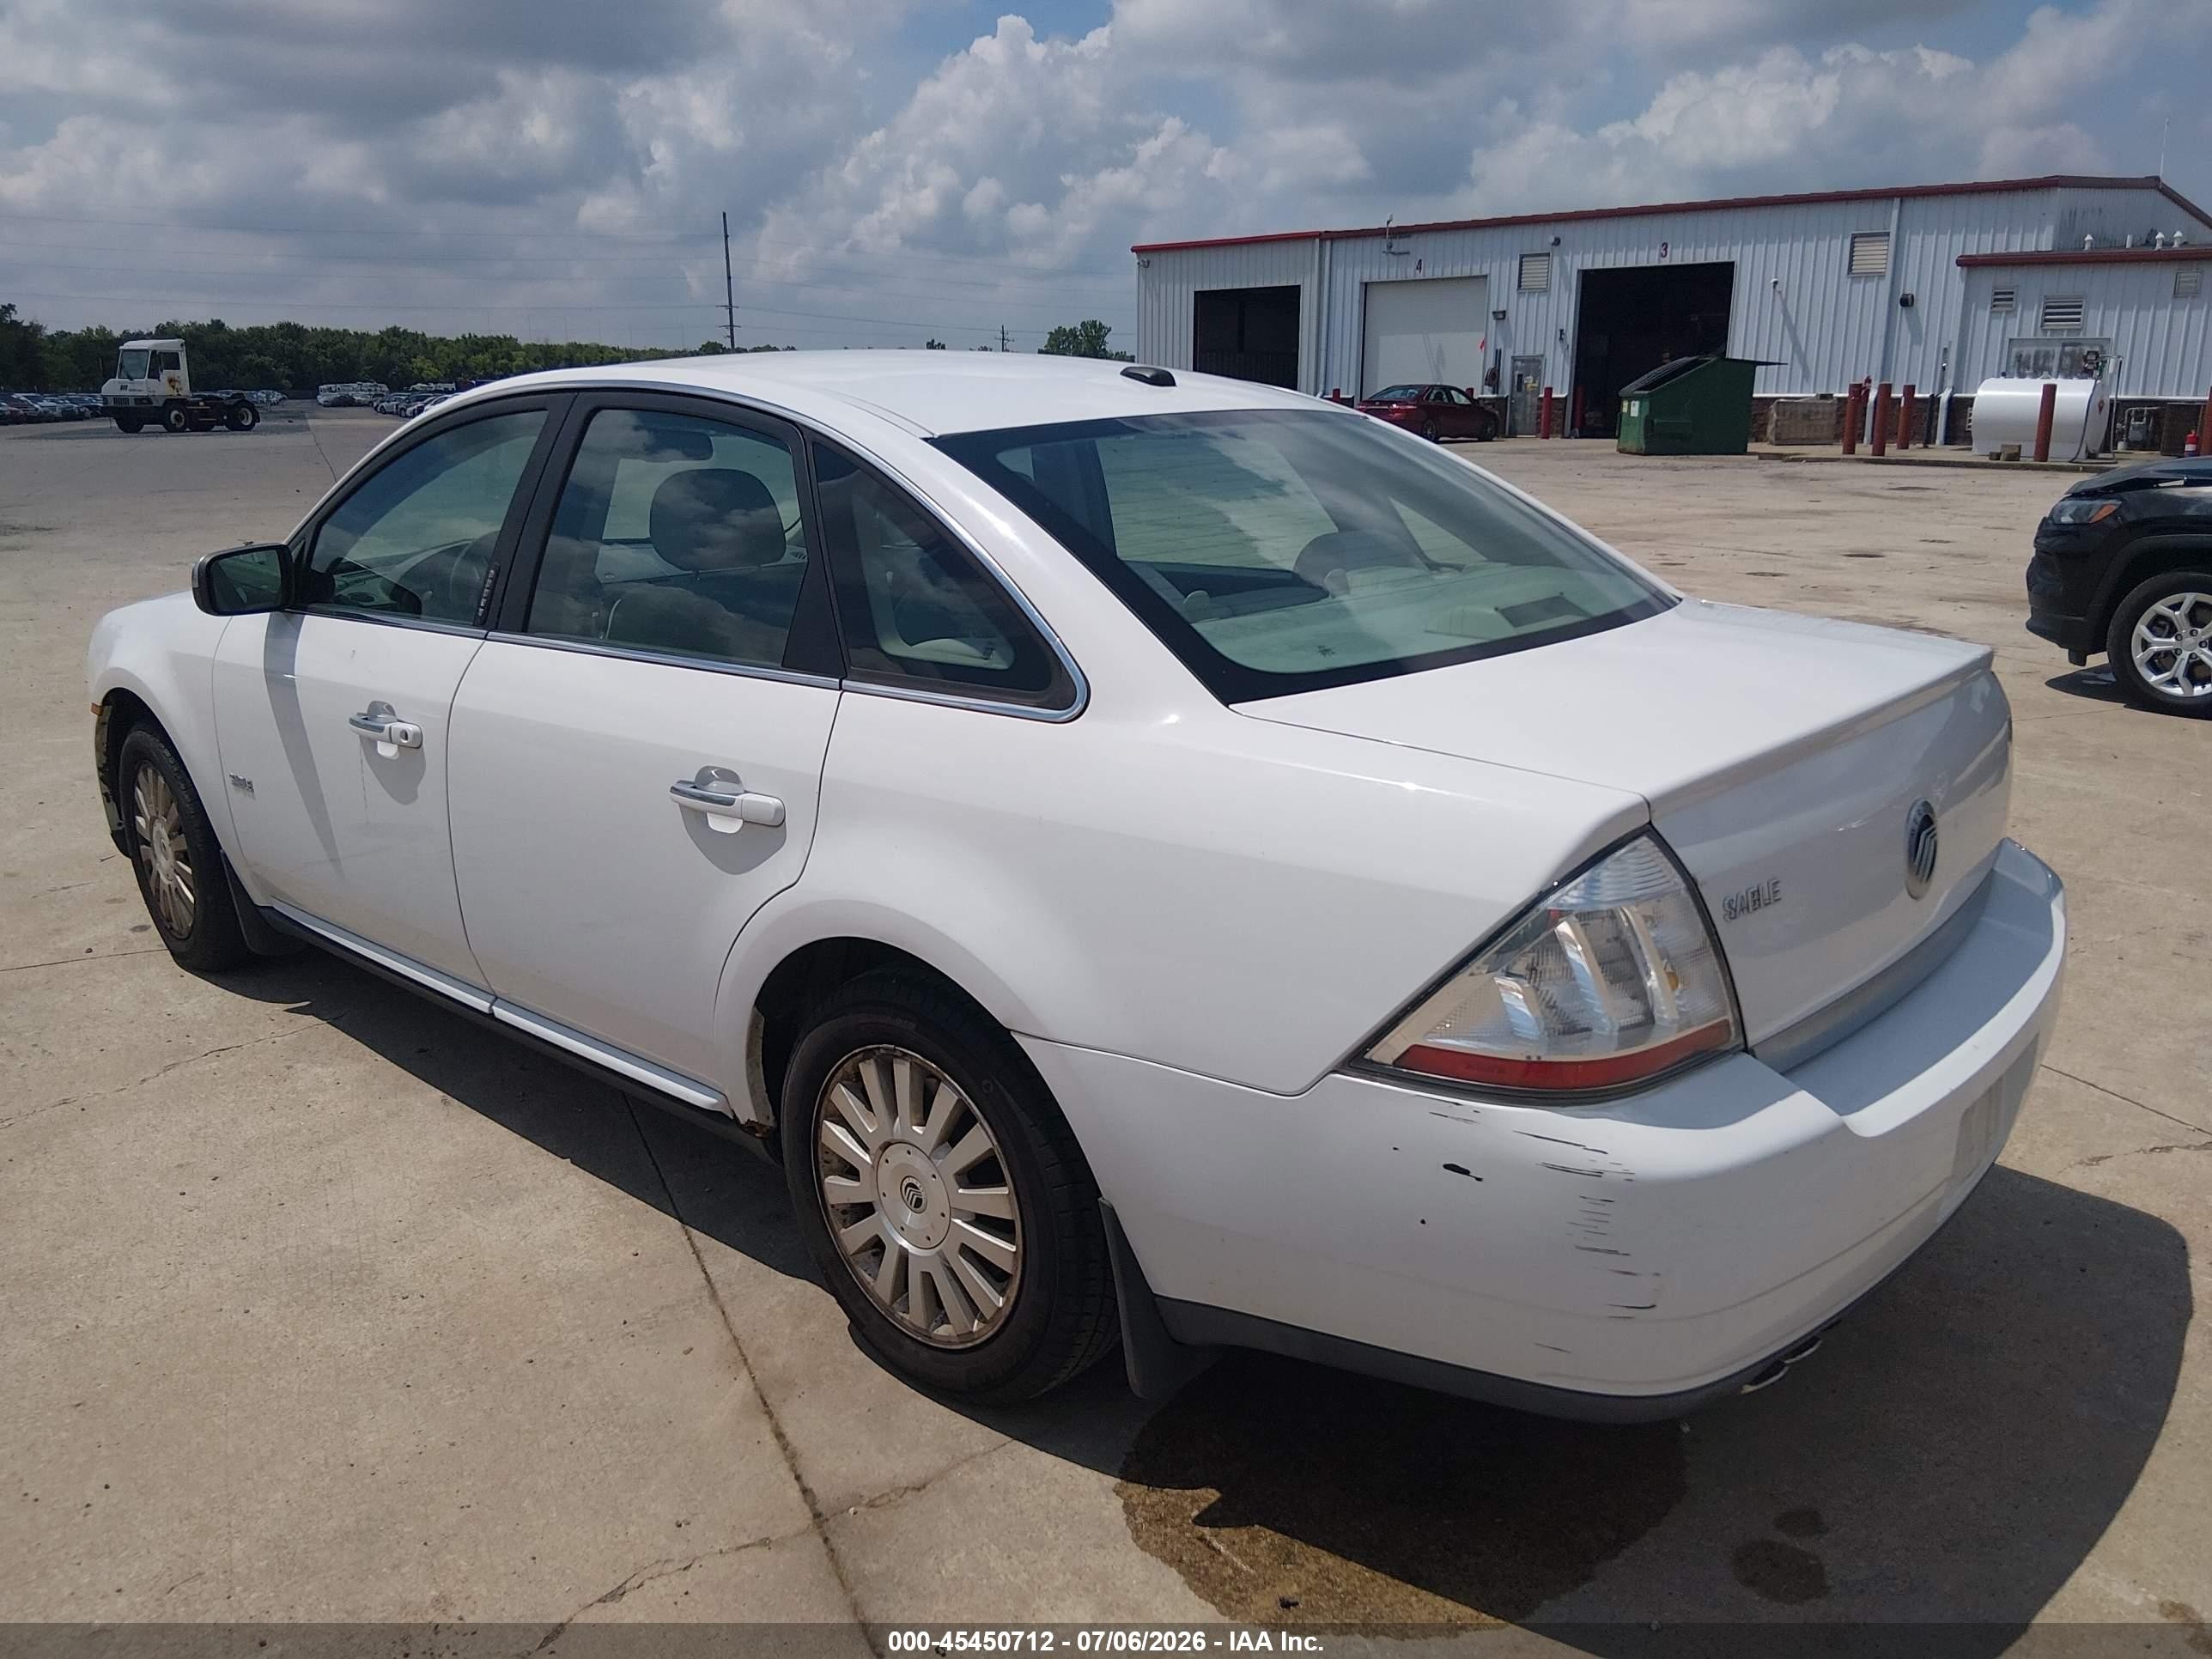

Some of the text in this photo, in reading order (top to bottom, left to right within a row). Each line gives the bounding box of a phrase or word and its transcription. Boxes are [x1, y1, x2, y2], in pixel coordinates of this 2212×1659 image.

[1661, 241, 1668, 258] 3
[1415, 258, 1423, 274] 4
[1723, 878, 1783, 921] SABLE
